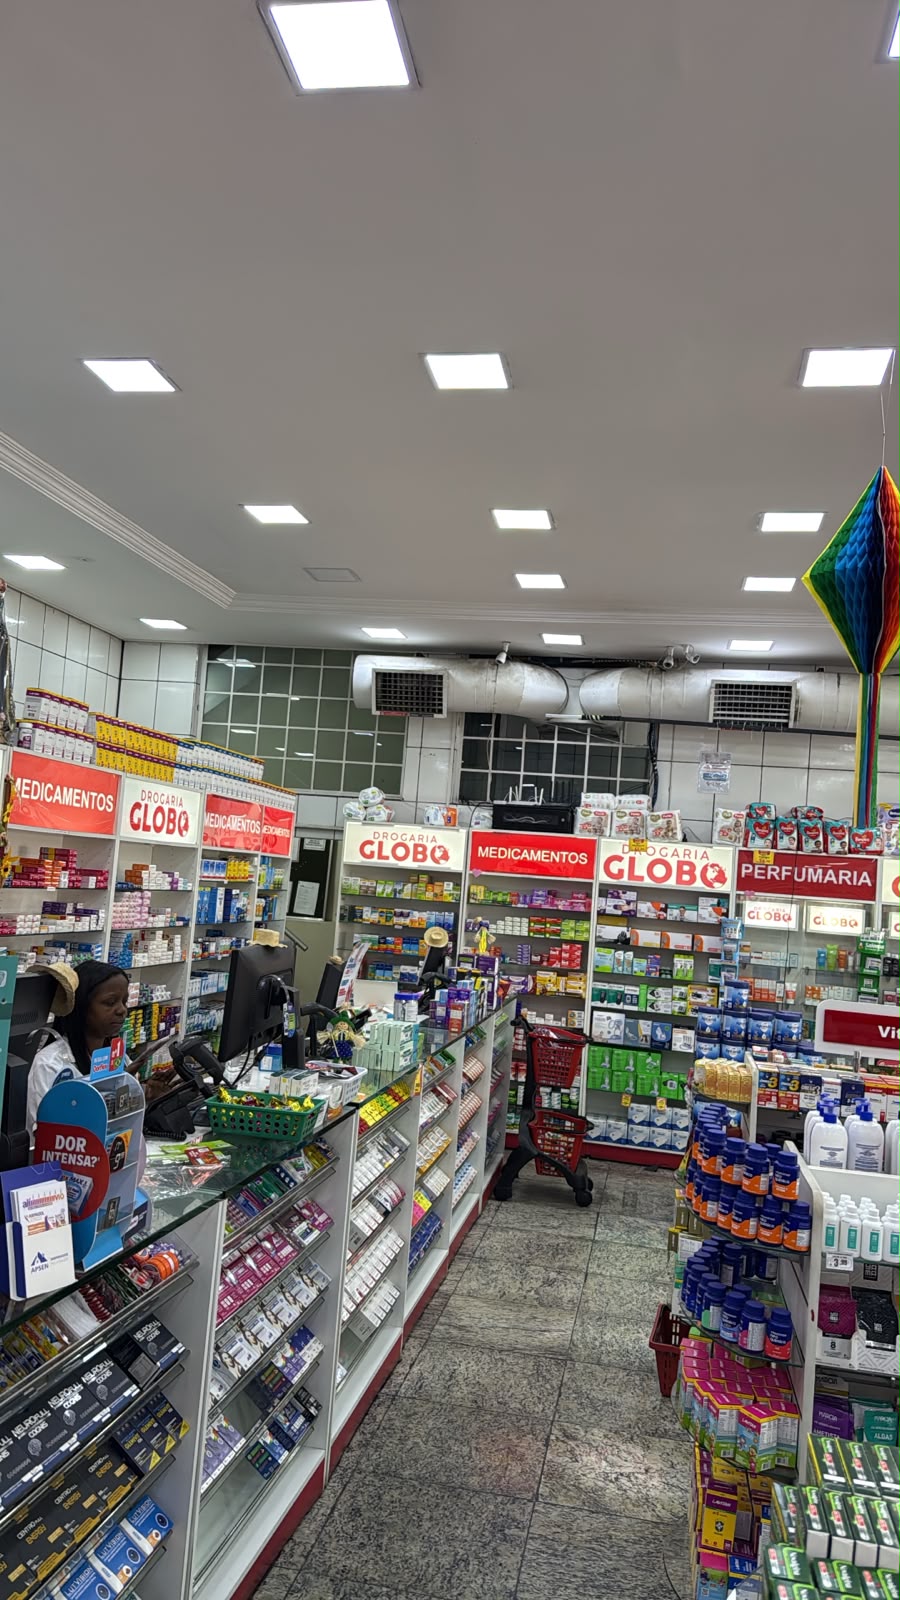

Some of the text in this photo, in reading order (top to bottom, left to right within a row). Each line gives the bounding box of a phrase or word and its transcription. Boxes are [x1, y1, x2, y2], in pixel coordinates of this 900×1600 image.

[140, 789, 184, 808] DROGARIA
[129, 801, 190, 837] GLOBO
[372, 831, 438, 844] DROGARIA
[359, 839, 450, 865] GLOBO
[477, 846, 588, 865] MEDICAMENTOS
[621, 842, 710, 861] DOGARIA
[603, 855, 729, 889] GLOBO
[741, 863, 873, 887] PERFUMARIA
[747, 910, 792, 923] GLOBO
[813, 916, 858, 928] GLOBO
[768, 1077, 778, 1089] 3
[789, 1079, 800, 1091] 3
[55, 1134, 87, 1152] DOR
[31, 1263, 49, 1274] APSEN
[830, 1341, 837, 1350] 8
[11, 1408, 50, 1437] NEUROFULL
